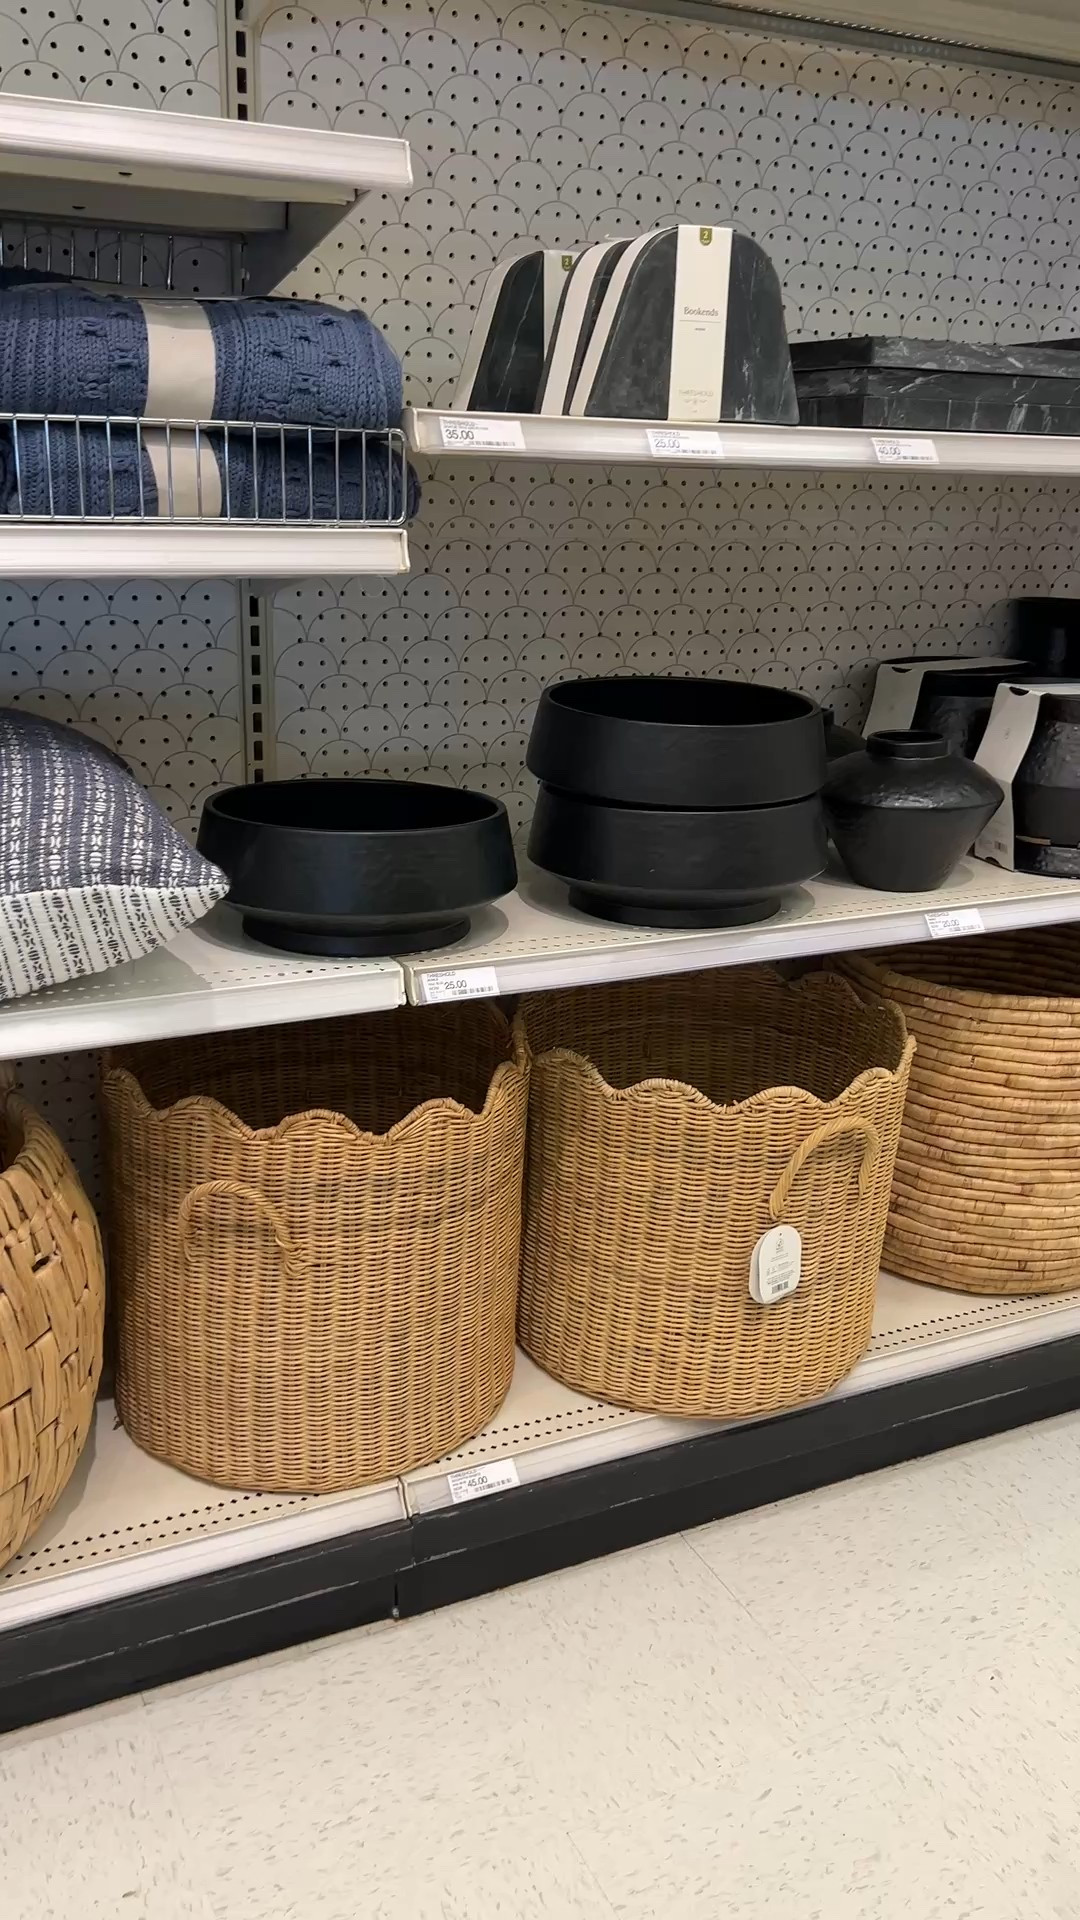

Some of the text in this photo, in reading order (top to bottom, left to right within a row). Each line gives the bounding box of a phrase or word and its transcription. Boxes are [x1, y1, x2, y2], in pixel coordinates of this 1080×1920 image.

[703, 231, 709, 239] 2
[684, 306, 719, 317] Bookends
[445, 429, 475, 440] 35.00
[654, 439, 680, 449] 25.00
[942, 919, 960, 928] 20.00
[444, 980, 467, 990] 25.00
[467, 1475, 488, 1487] 45.00
